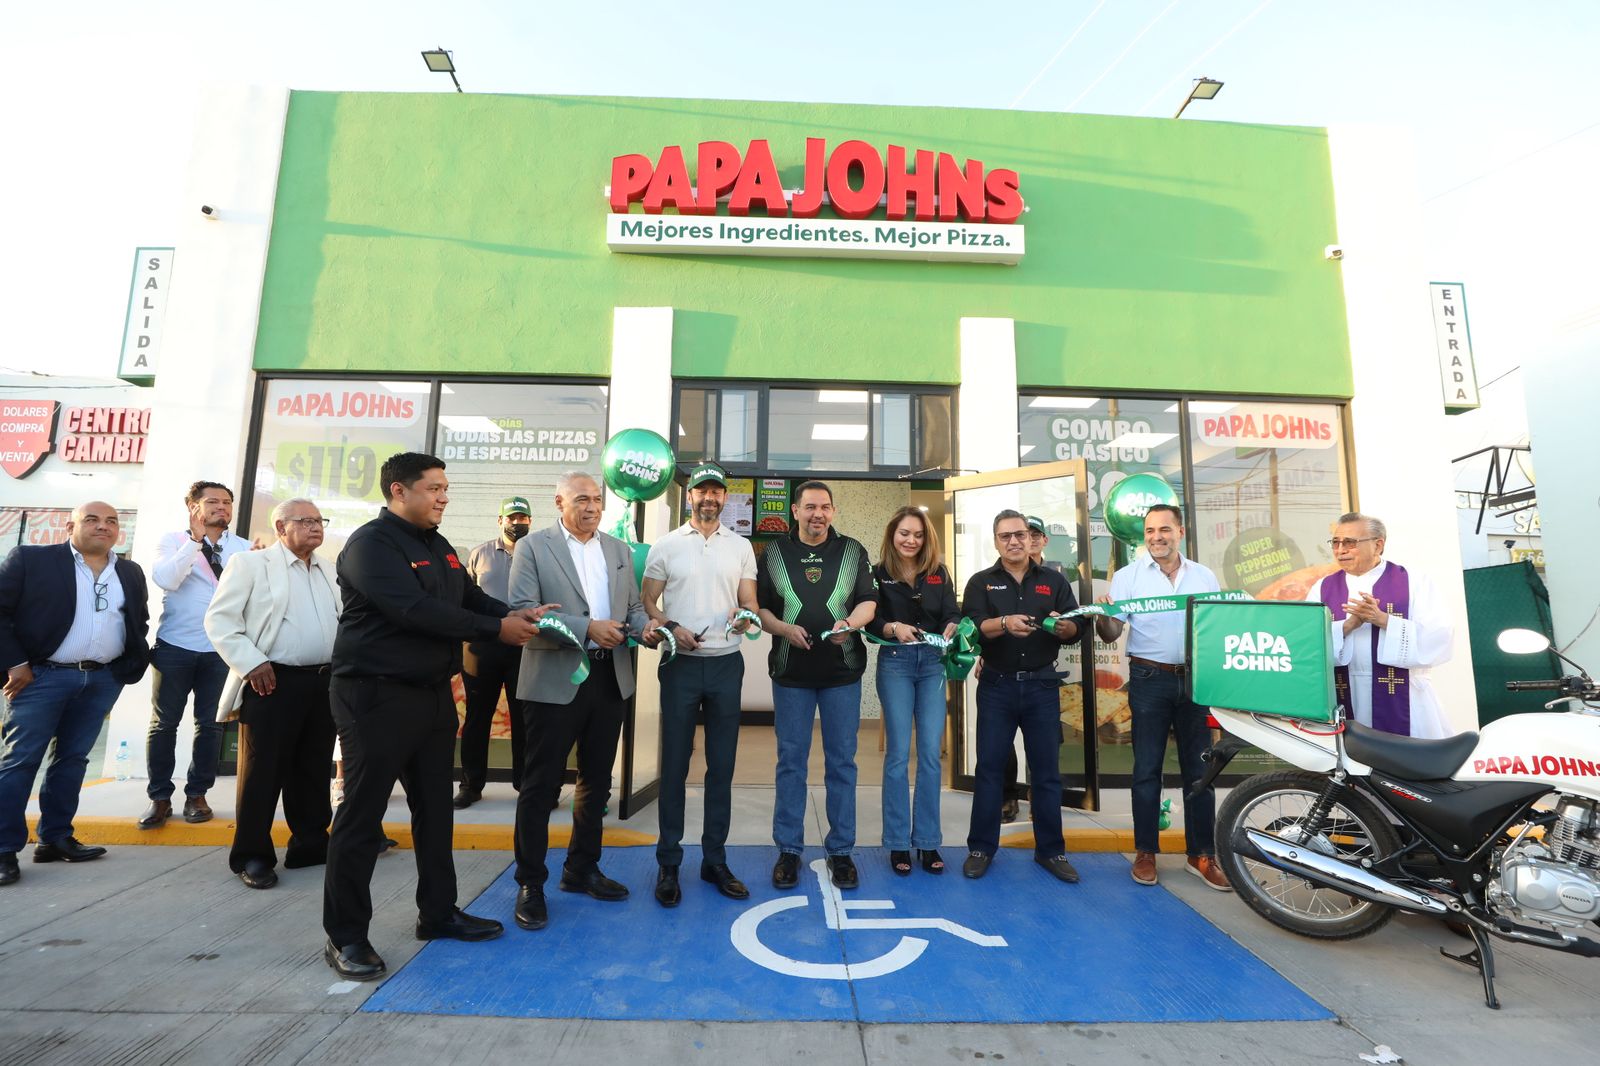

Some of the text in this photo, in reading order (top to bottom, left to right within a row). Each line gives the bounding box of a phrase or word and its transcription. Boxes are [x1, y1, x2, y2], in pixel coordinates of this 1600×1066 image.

[609, 137, 1024, 223] PAPA JOHNS
[620, 220, 1011, 248] Mejores Ingredientes. Mejor Pizza.
[134, 257, 160, 367] SALIDA
[1441, 289, 1467, 400] ENTRADA
[3, 407, 48, 417] DOLARES
[277, 391, 414, 419] PAPA JOHNS
[0, 423, 45, 433] COMPRA
[446, 429, 596, 446] TODAS LAS PIZZAS
[1051, 418, 1151, 441] COMBO
[1204, 414, 1331, 441] PAPA JOHNS
[17, 440, 24, 448] Y
[443, 446, 589, 462] DE ESPECIALIDAD
[0, 451, 35, 462] VENTA
[619, 462, 660, 483] JOHNS
[1240, 536, 1274, 557] SUPER
[1234, 547, 1291, 577] PEPPERONI
[1120, 599, 1177, 614] PAPA JOHNS
[1224, 631, 1291, 655] PAPA
[1222, 654, 1293, 673] JOHNS
[1474, 755, 1600, 777] PAPA JOHN
[1561, 892, 1592, 905] HONDA
